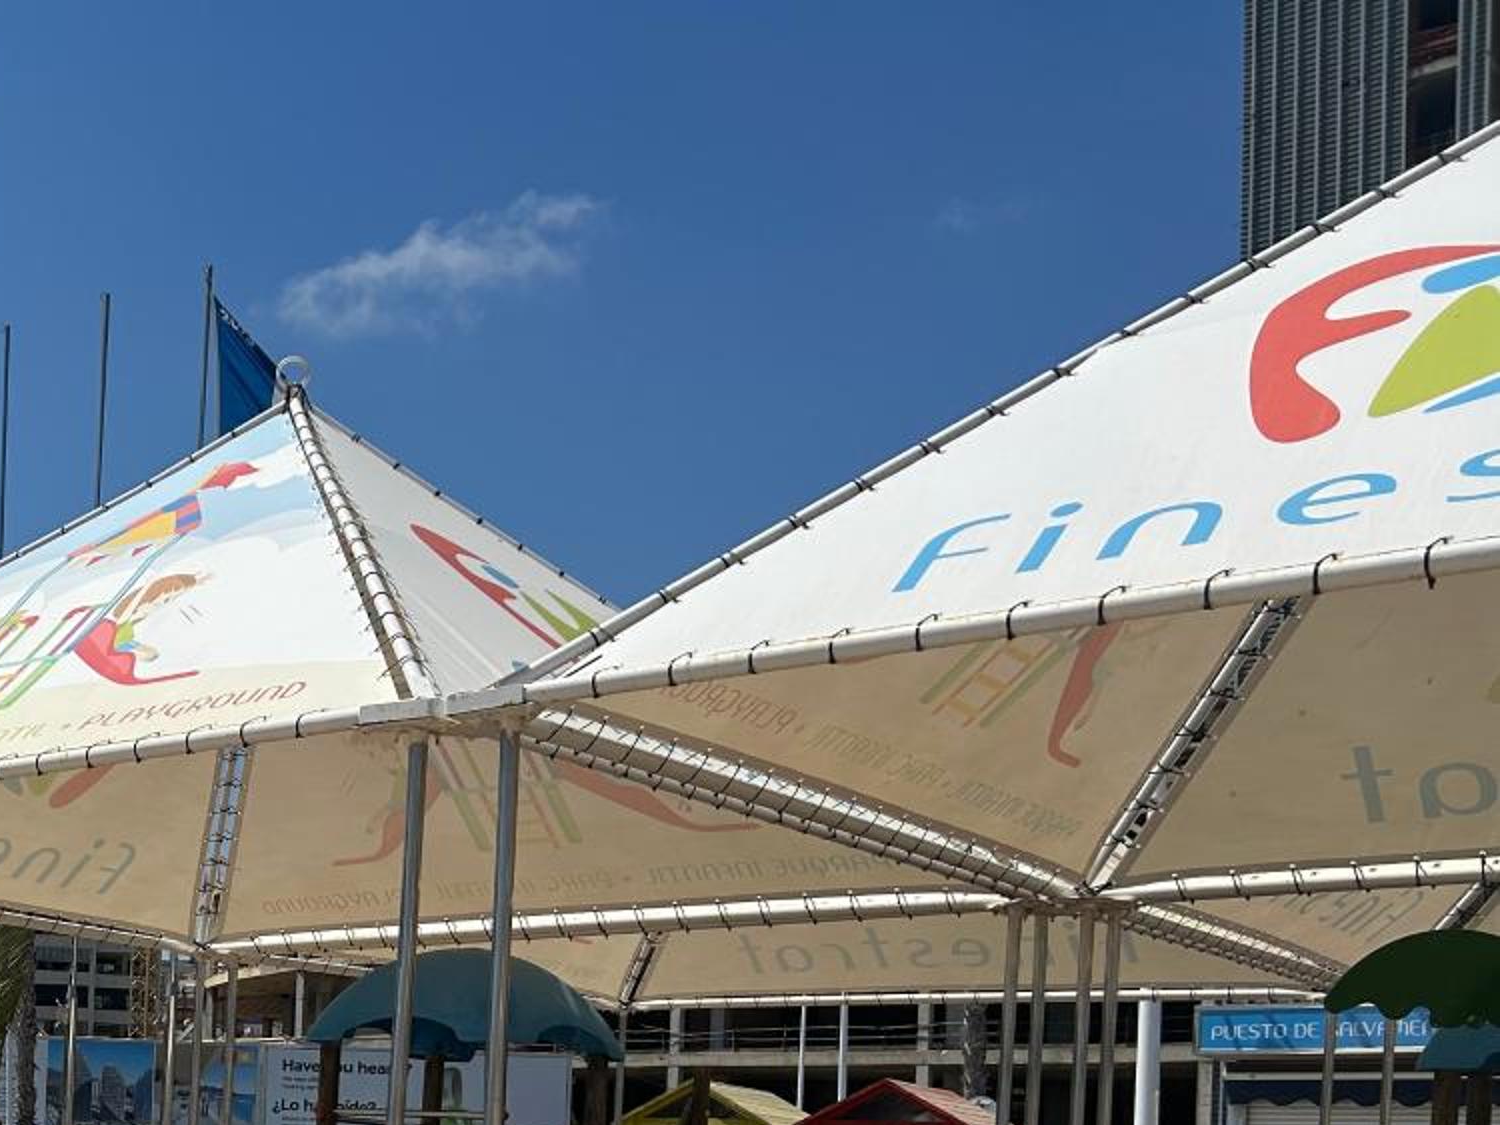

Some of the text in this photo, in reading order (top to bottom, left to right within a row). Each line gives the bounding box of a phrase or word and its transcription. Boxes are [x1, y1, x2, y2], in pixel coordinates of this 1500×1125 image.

[77, 680, 307, 730] PLAYGROUND
[1210, 1021, 1288, 1041] PUESTO
[1293, 1020, 1321, 1040] DE
[281, 1058, 320, 1074] Have
[272, 1098, 300, 1115] ¿Lo
